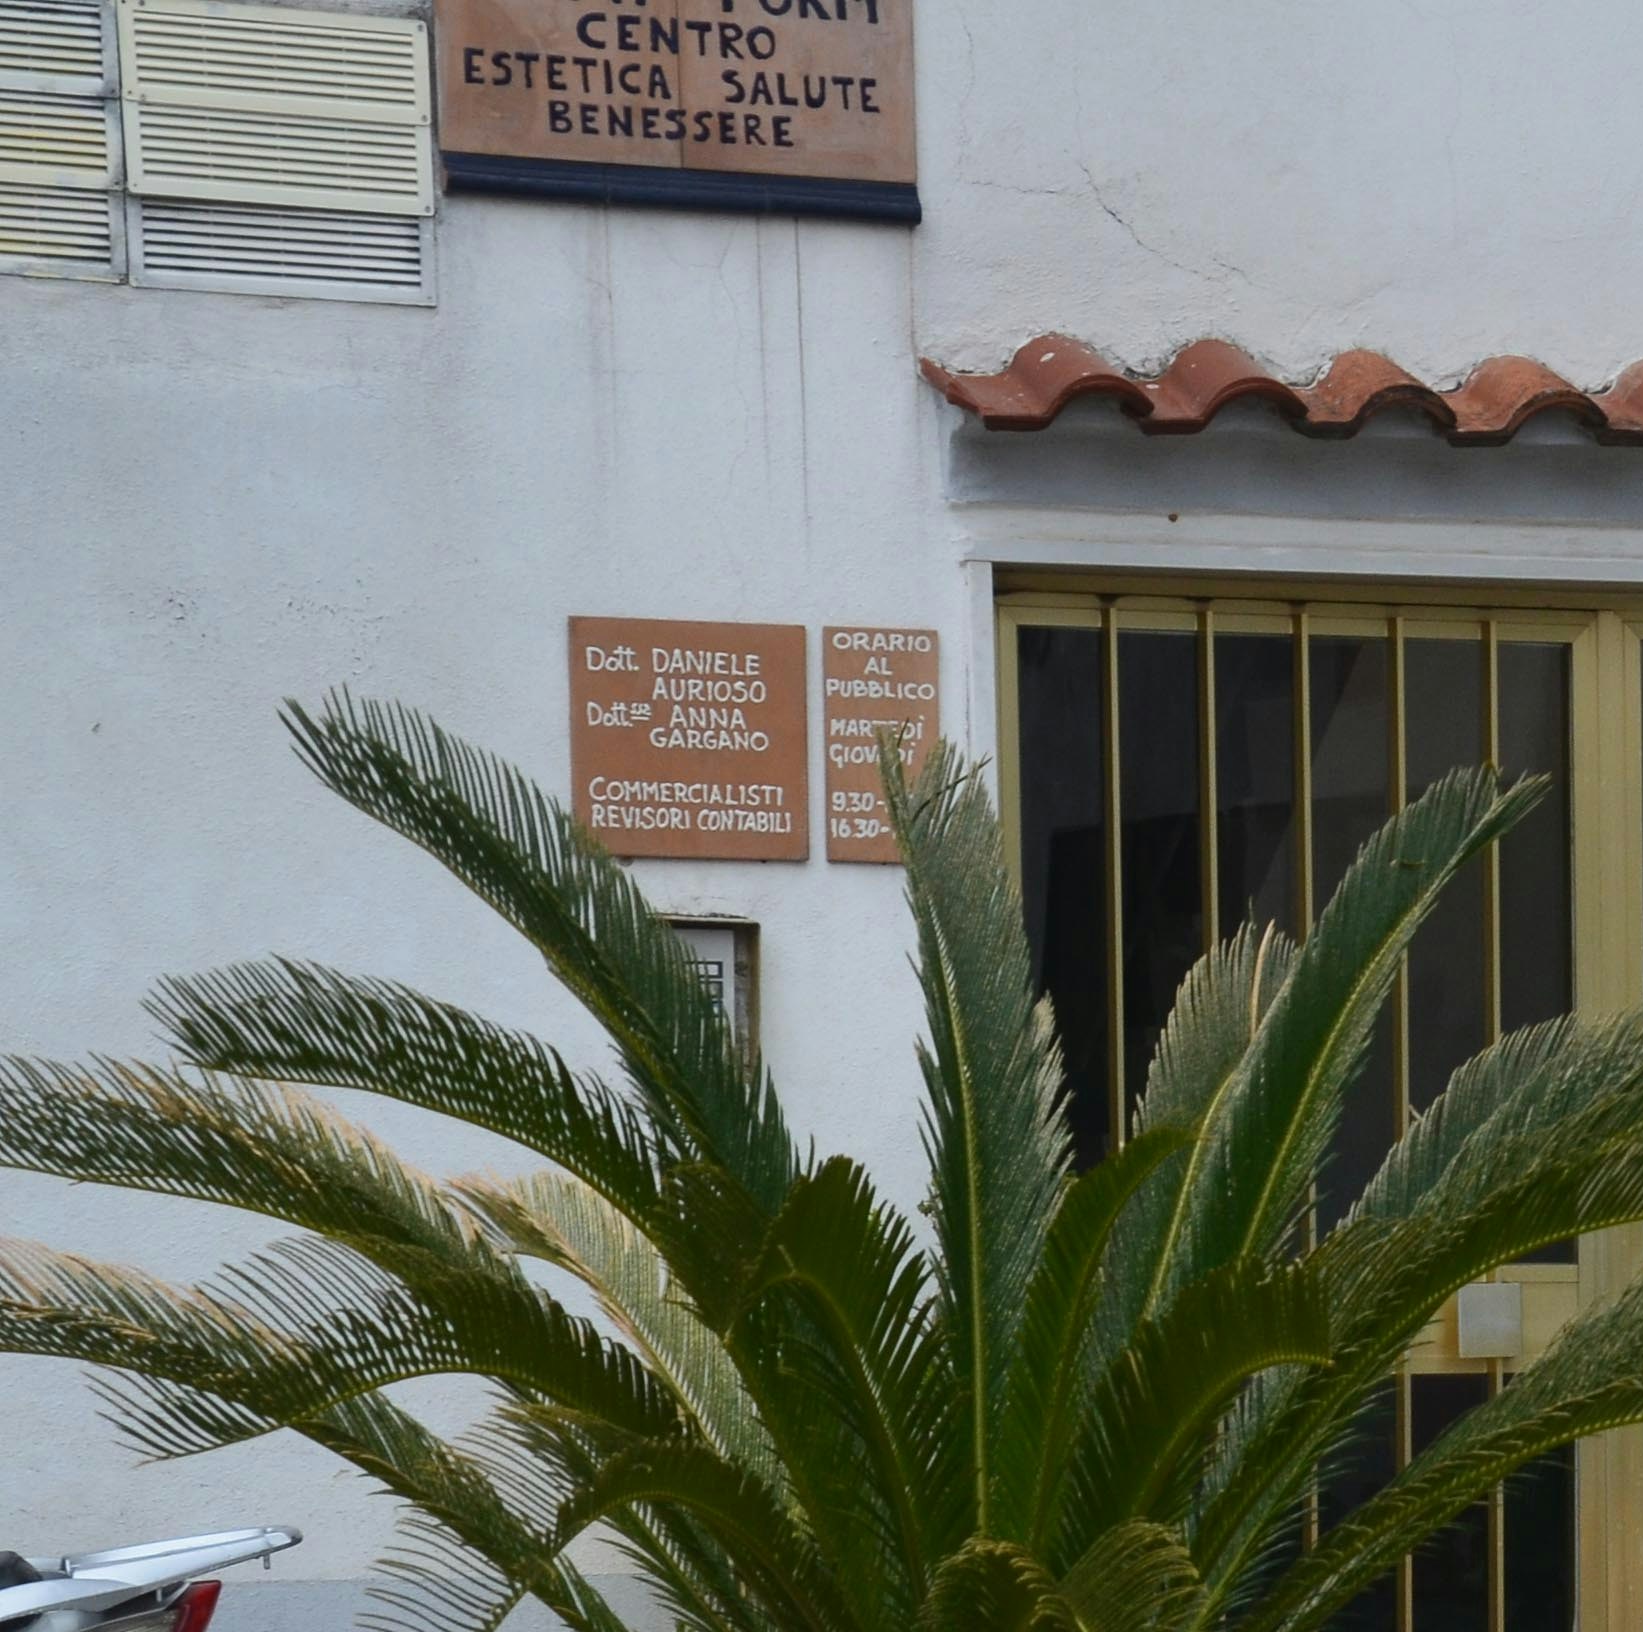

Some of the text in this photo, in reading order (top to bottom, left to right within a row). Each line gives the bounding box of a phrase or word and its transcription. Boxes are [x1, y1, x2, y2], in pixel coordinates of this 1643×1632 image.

[577, 12, 777, 61] CENTRO
[463, 47, 881, 113] ESTETICA SALUTE
[547, 100, 795, 148] BENESSERE
[832, 632, 932, 652] ORARIO
[585, 645, 760, 676] Dott. DANIELE
[863, 656, 893, 676] AL
[652, 676, 767, 703] AURIOSO
[825, 678, 935, 700] PUBBLICO
[669, 704, 747, 730] ANNA
[649, 727, 770, 751] GARGANO
[829, 742, 916, 769] GIOVDÌ
[588, 776, 784, 806] COMMERCIALISTI
[591, 803, 792, 833] REVISORI CONTABILI
